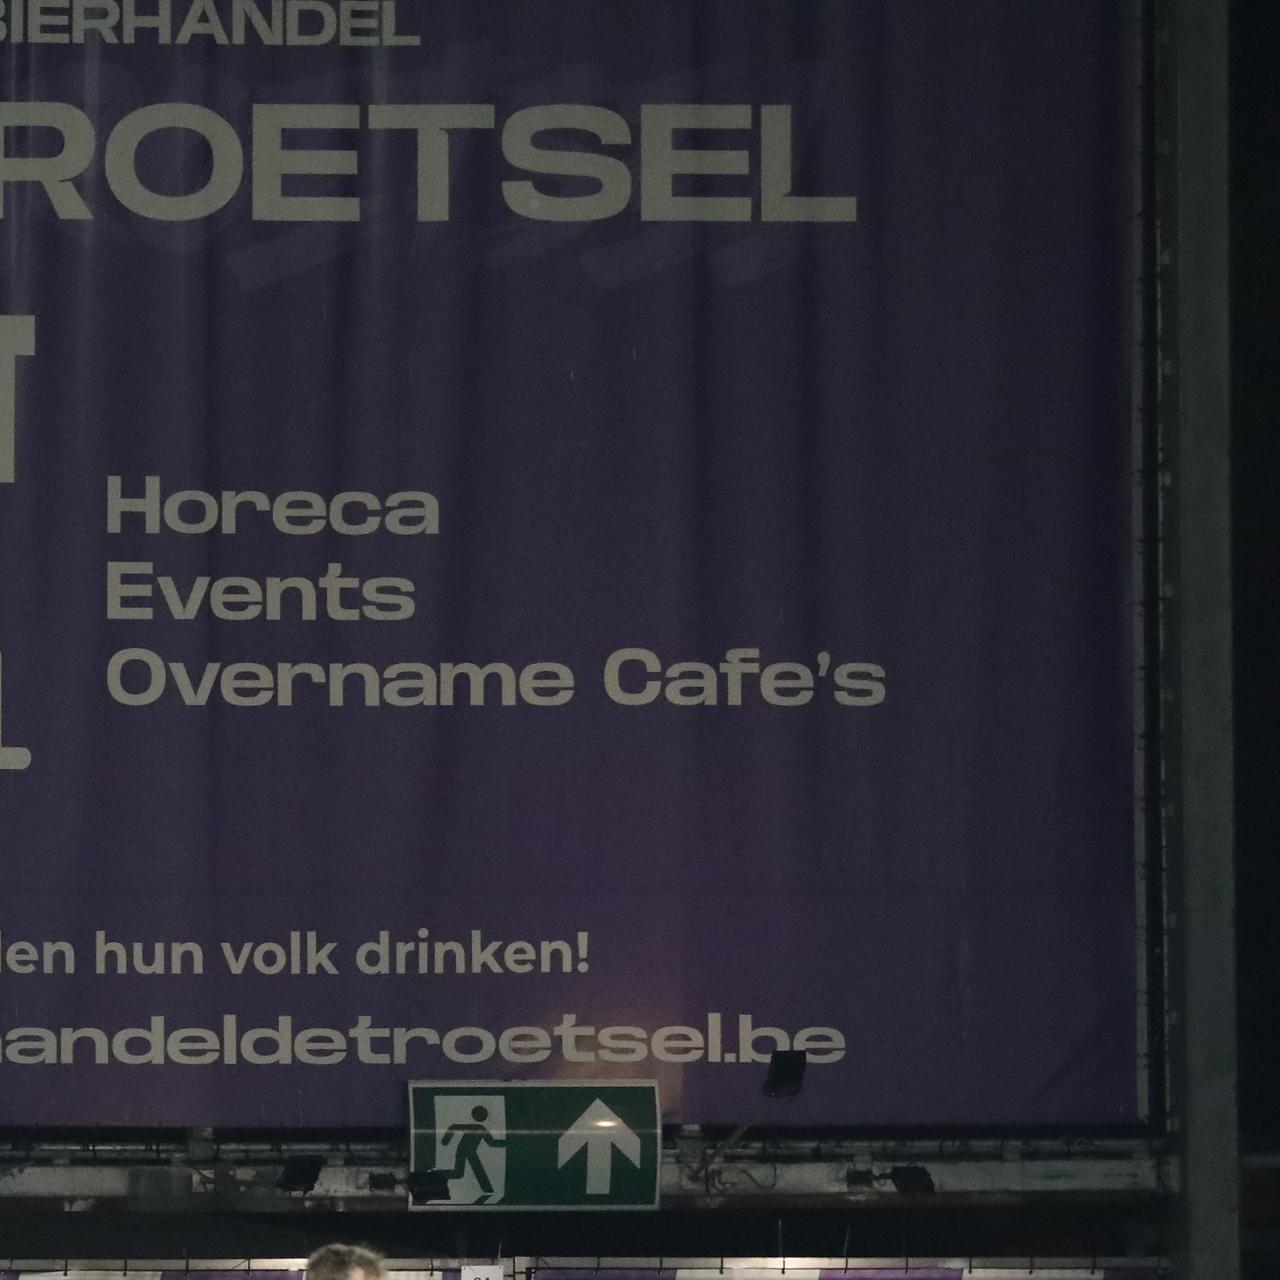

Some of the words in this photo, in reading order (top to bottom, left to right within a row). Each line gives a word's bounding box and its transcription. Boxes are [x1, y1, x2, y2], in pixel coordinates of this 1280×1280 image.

[107, 475, 440, 536] Horeca
[107, 561, 416, 621] Events
[107, 647, 575, 707] Overname
[603, 647, 886, 707] Cafe's
[95, 930, 204, 975] hun
[220, 930, 339, 975] volk
[355, 927, 590, 975] drinken!
